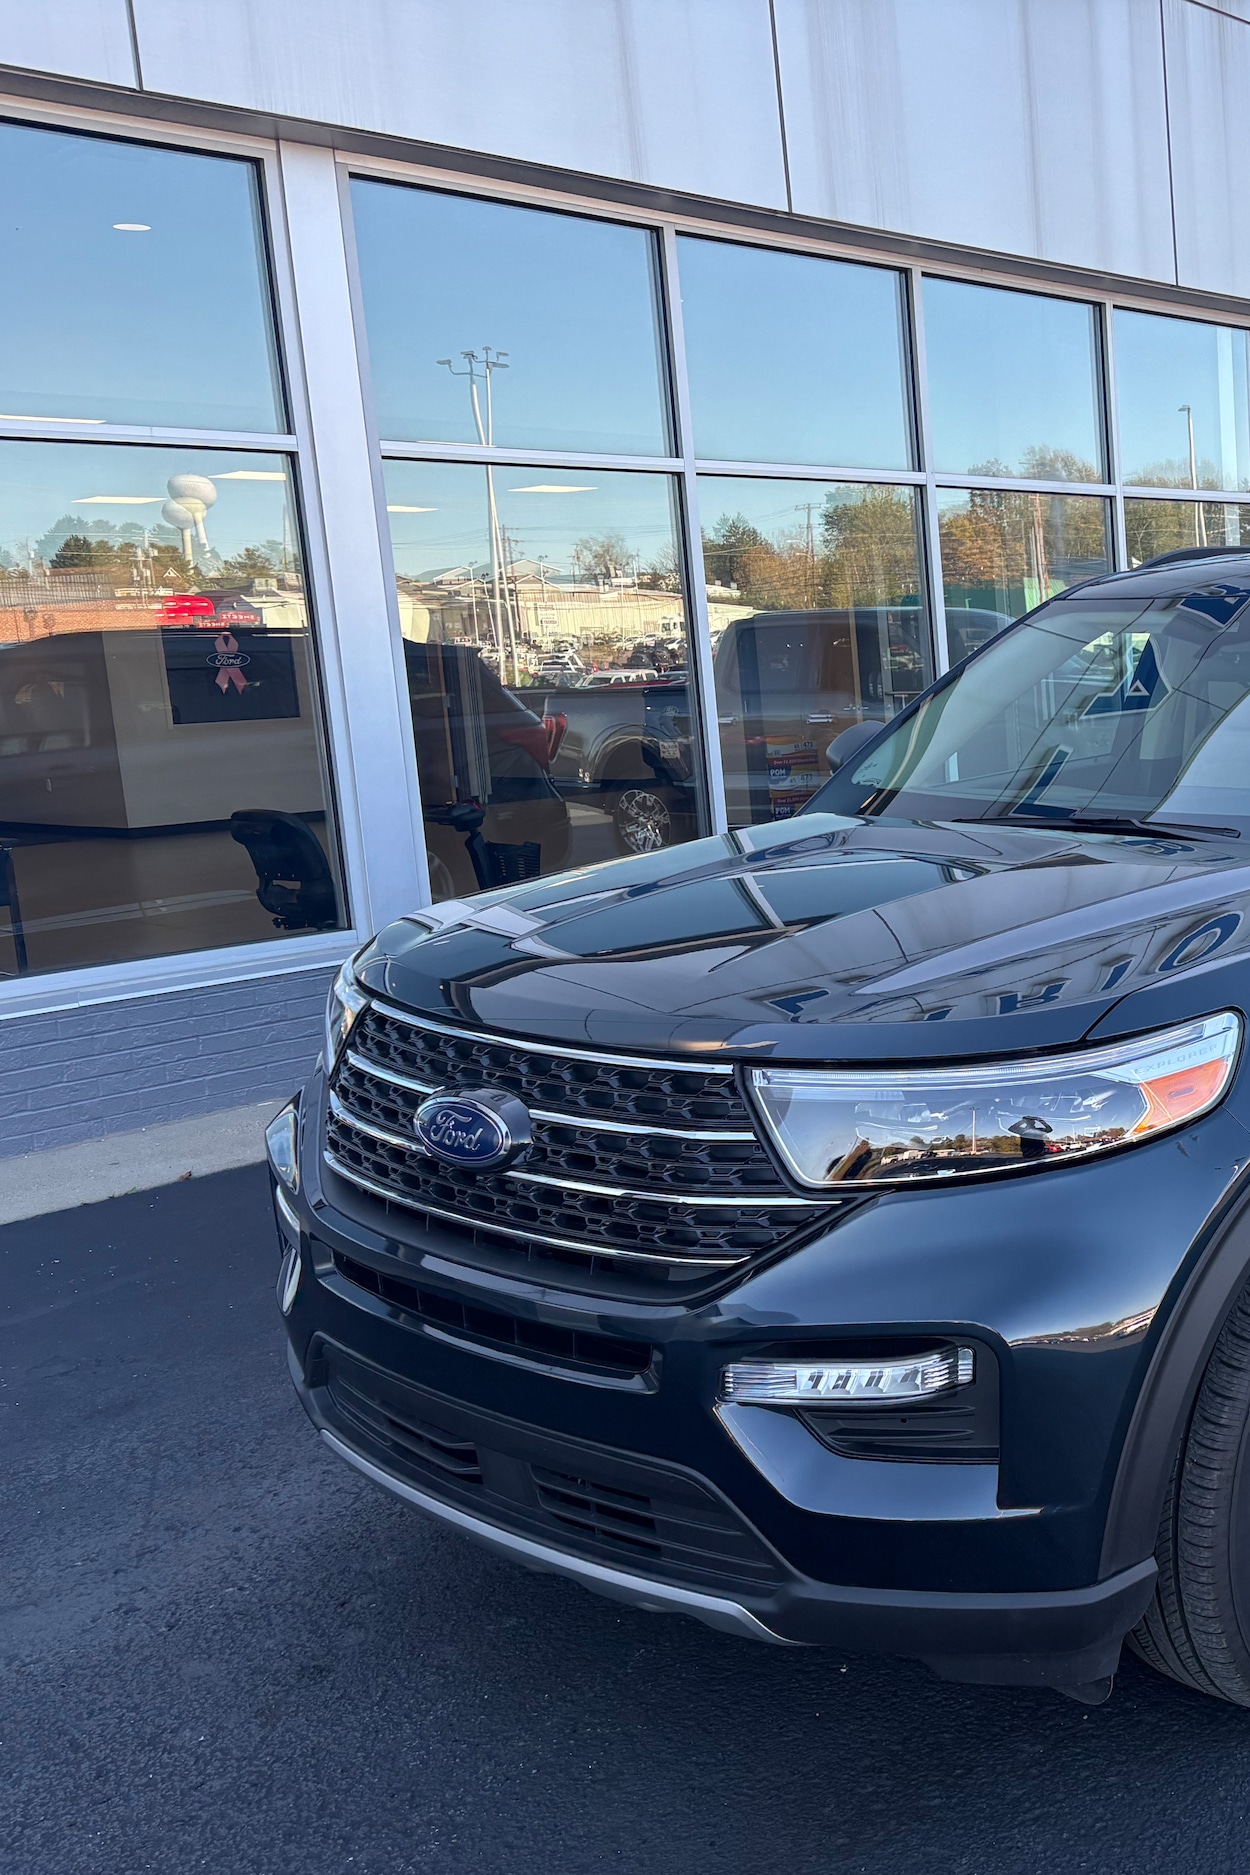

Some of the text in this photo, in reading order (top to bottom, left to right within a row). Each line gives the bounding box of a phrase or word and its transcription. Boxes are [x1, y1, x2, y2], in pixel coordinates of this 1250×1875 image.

[215, 653, 242, 665] Ford
[1133, 1043, 1218, 1075] EXPLORER
[430, 1109, 484, 1151] Ford
